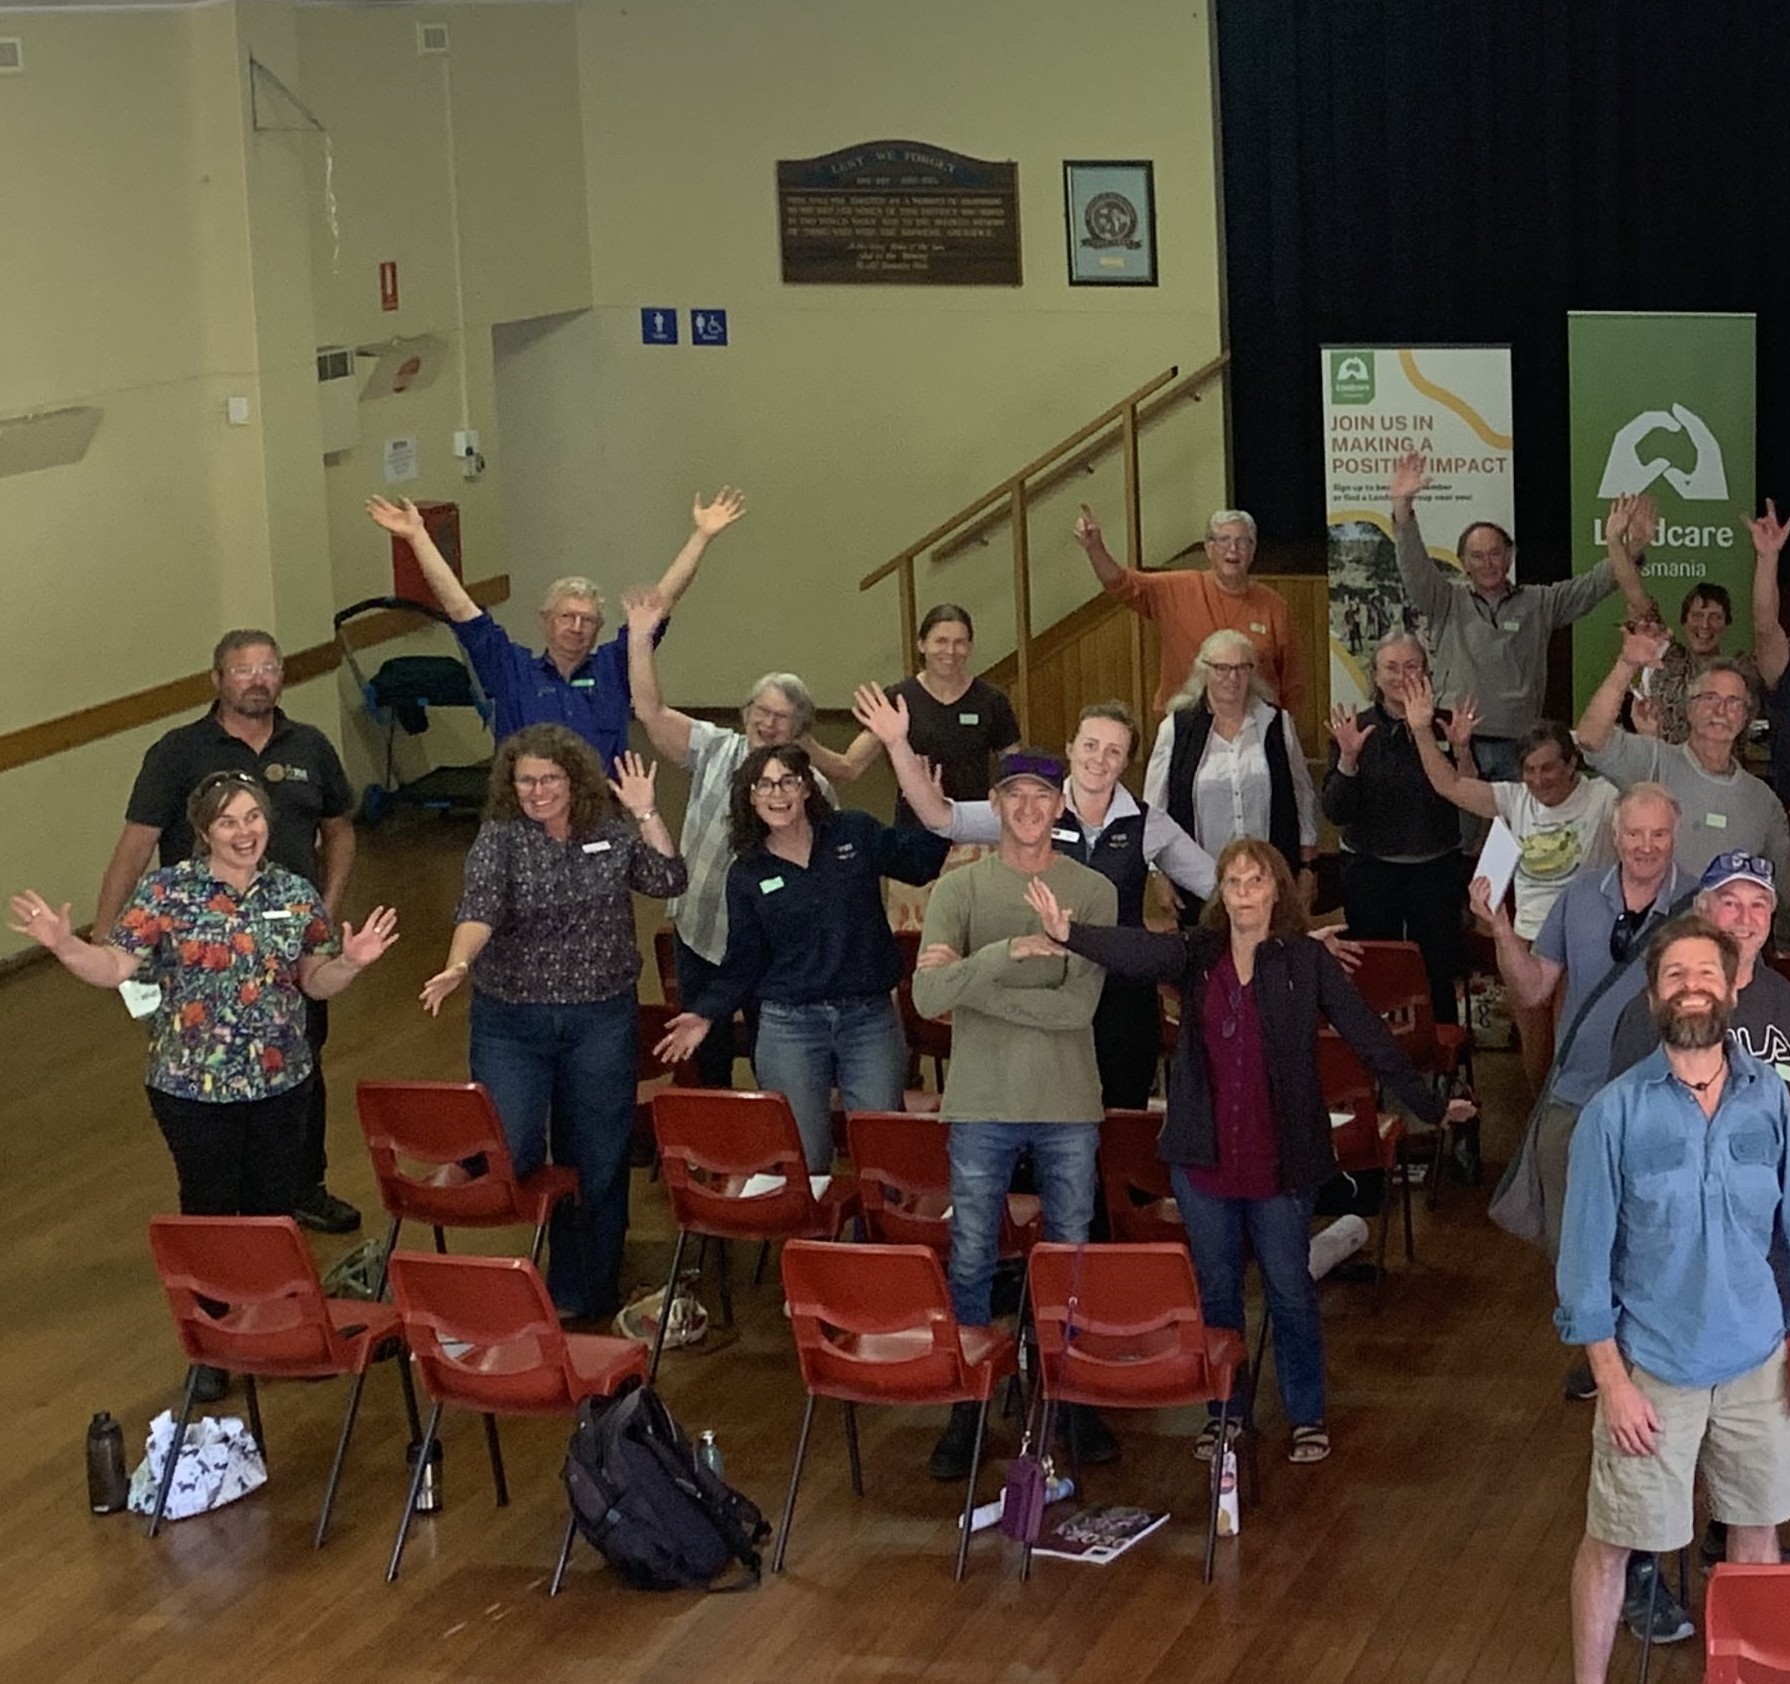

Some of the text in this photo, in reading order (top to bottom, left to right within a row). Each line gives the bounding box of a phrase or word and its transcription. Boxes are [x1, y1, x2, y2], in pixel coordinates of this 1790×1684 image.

[875, 151, 896, 161] WE
[1331, 415, 1434, 431] JOIN US IN
[1331, 437, 1434, 453] MAKING A
[1429, 457, 1508, 474] IMPACT
[1594, 517, 1735, 548] Ldcare
[1641, 559, 1707, 578] smania
